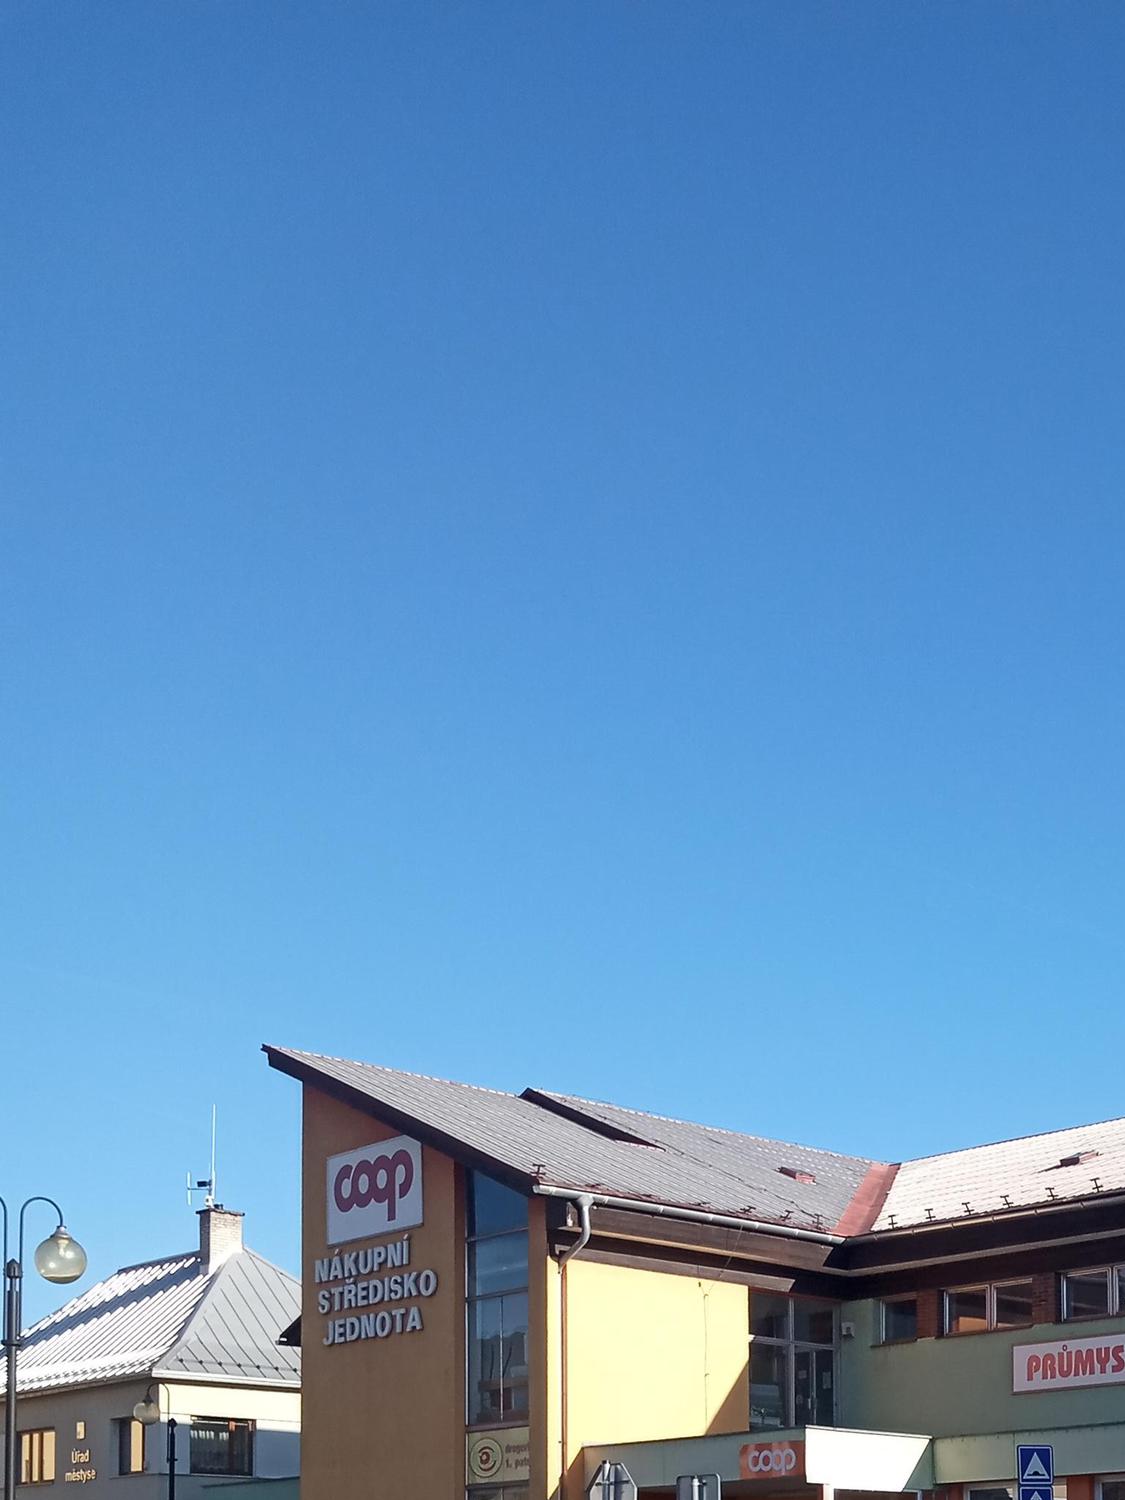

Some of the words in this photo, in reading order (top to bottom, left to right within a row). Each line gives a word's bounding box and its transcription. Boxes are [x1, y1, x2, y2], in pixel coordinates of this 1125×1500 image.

[334, 1149, 414, 1222] coop
[314, 1233, 410, 1283] NÁKUPNÍ
[317, 1269, 438, 1315] STŘEDISKO
[322, 1306, 424, 1346] JEDNOTA
[64, 1468, 97, 1484] městyse
[71, 1448, 90, 1464] Úřad
[748, 1448, 796, 1475] coop
